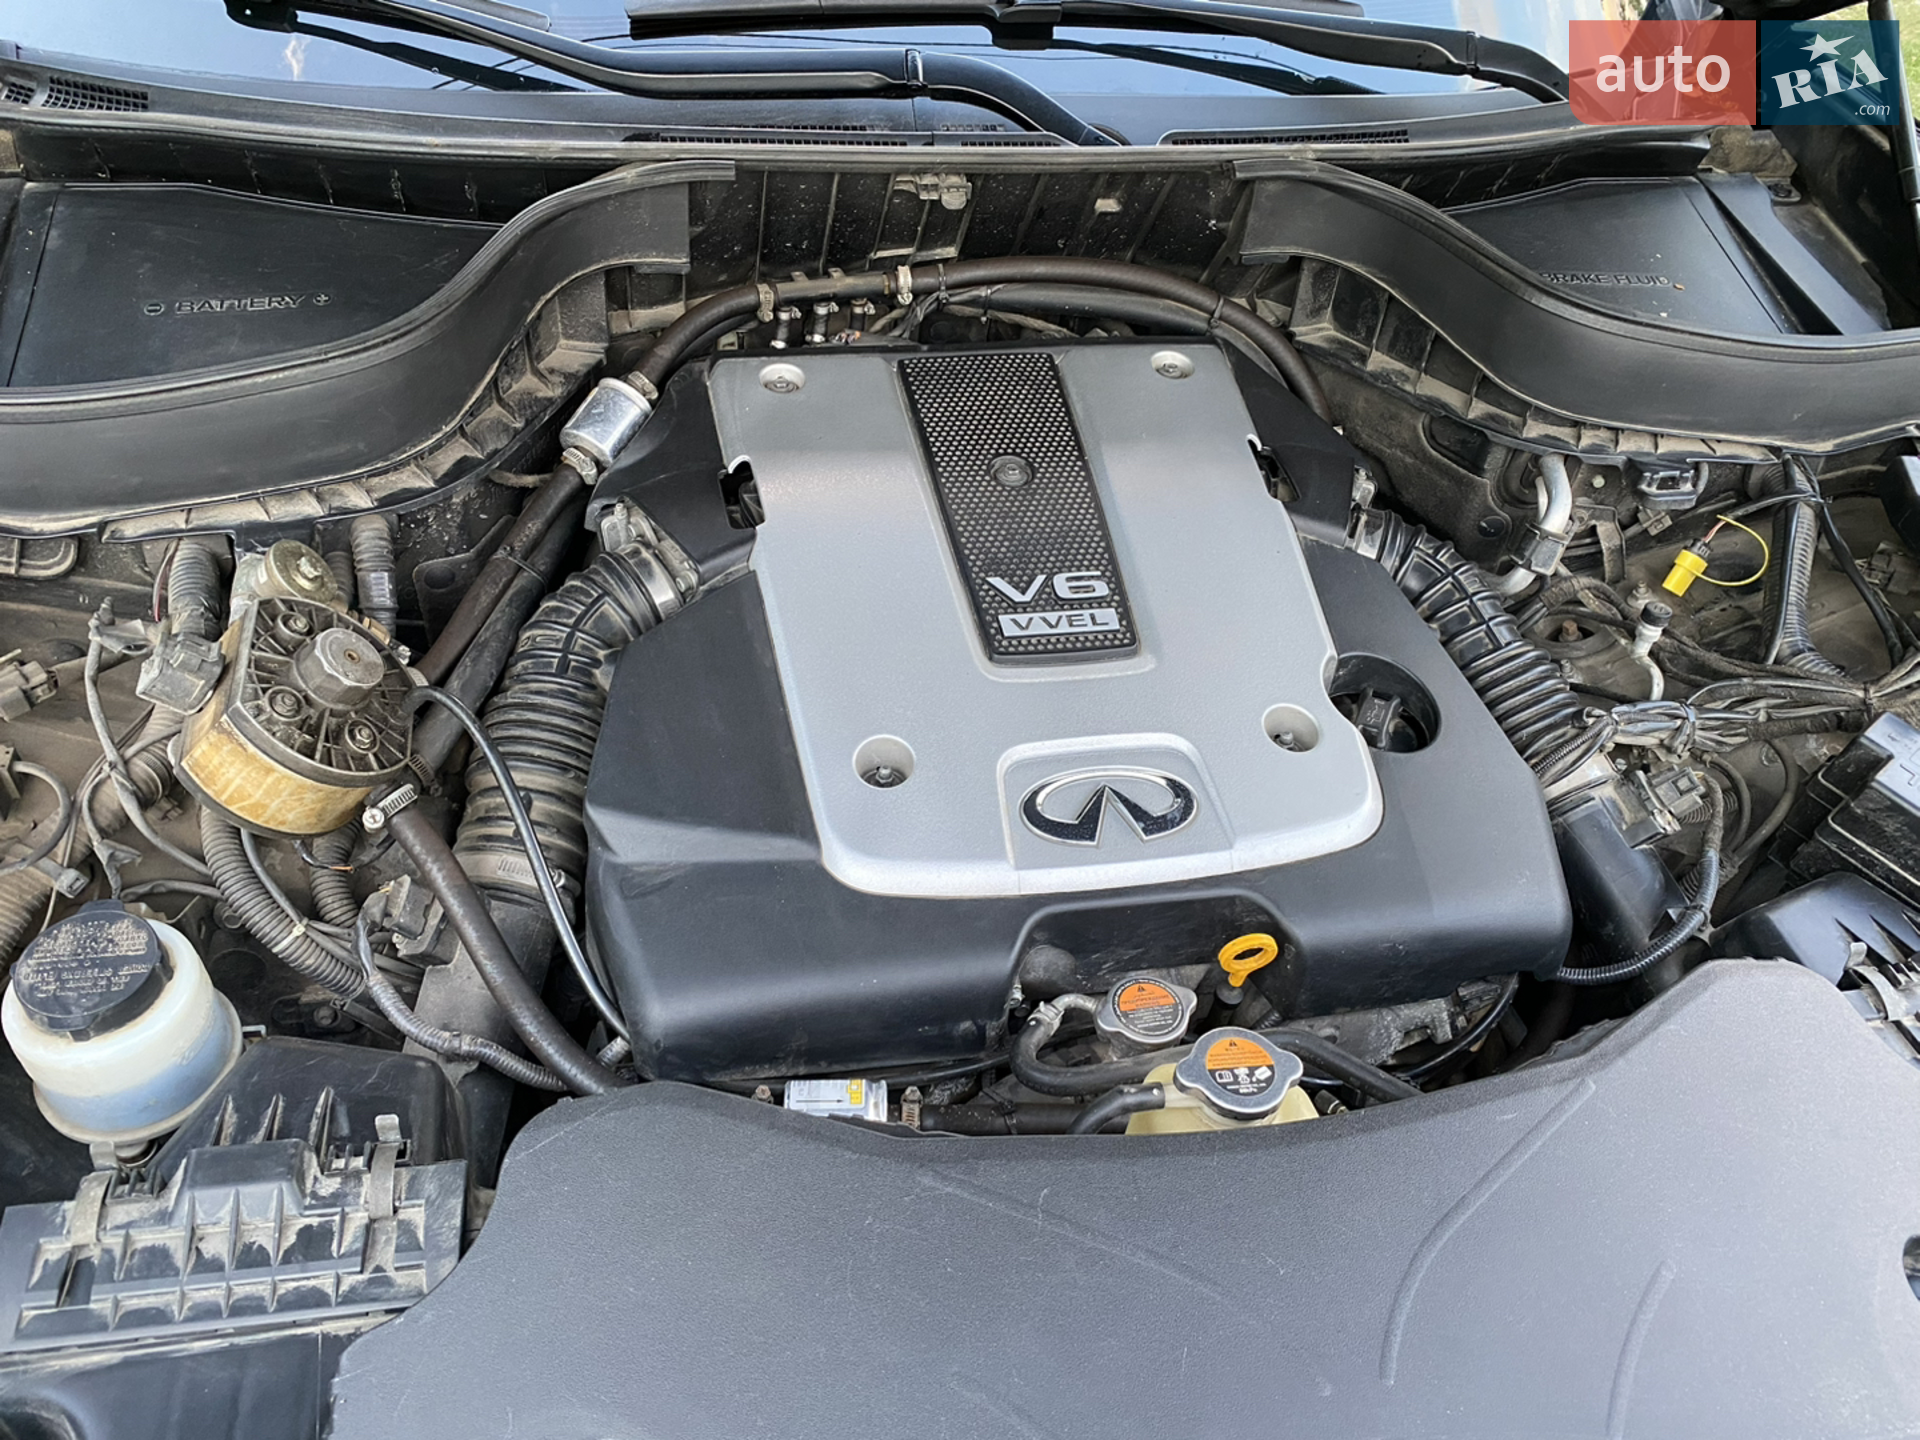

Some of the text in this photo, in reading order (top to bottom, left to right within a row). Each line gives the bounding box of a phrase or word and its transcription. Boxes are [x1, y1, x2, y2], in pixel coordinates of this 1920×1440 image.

[1613, 274, 1672, 287] FLUID
[175, 295, 306, 314] BATTERY
[985, 571, 1109, 603] V6
[1010, 613, 1109, 631] VVEL
